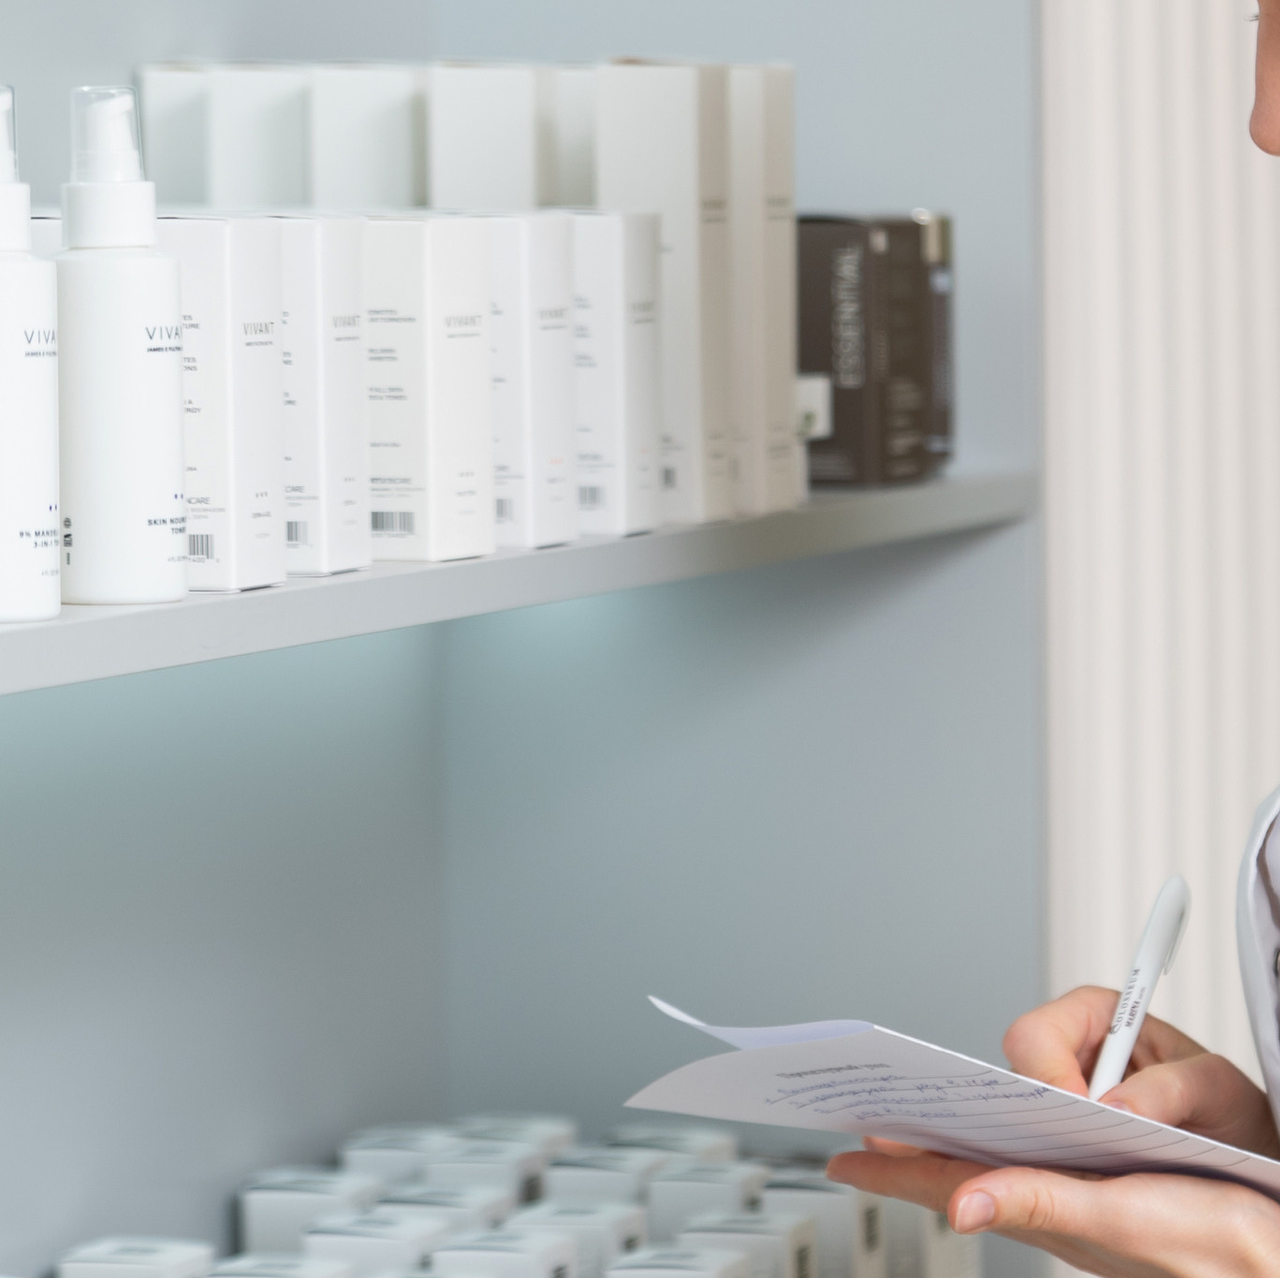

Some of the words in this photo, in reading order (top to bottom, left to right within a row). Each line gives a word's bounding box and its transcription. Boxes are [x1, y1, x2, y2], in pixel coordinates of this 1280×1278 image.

[243, 322, 274, 336] VIVANT
[1110, 968, 1141, 1035] COLOSSEUM
[1125, 1000, 1141, 1028] MARINA
